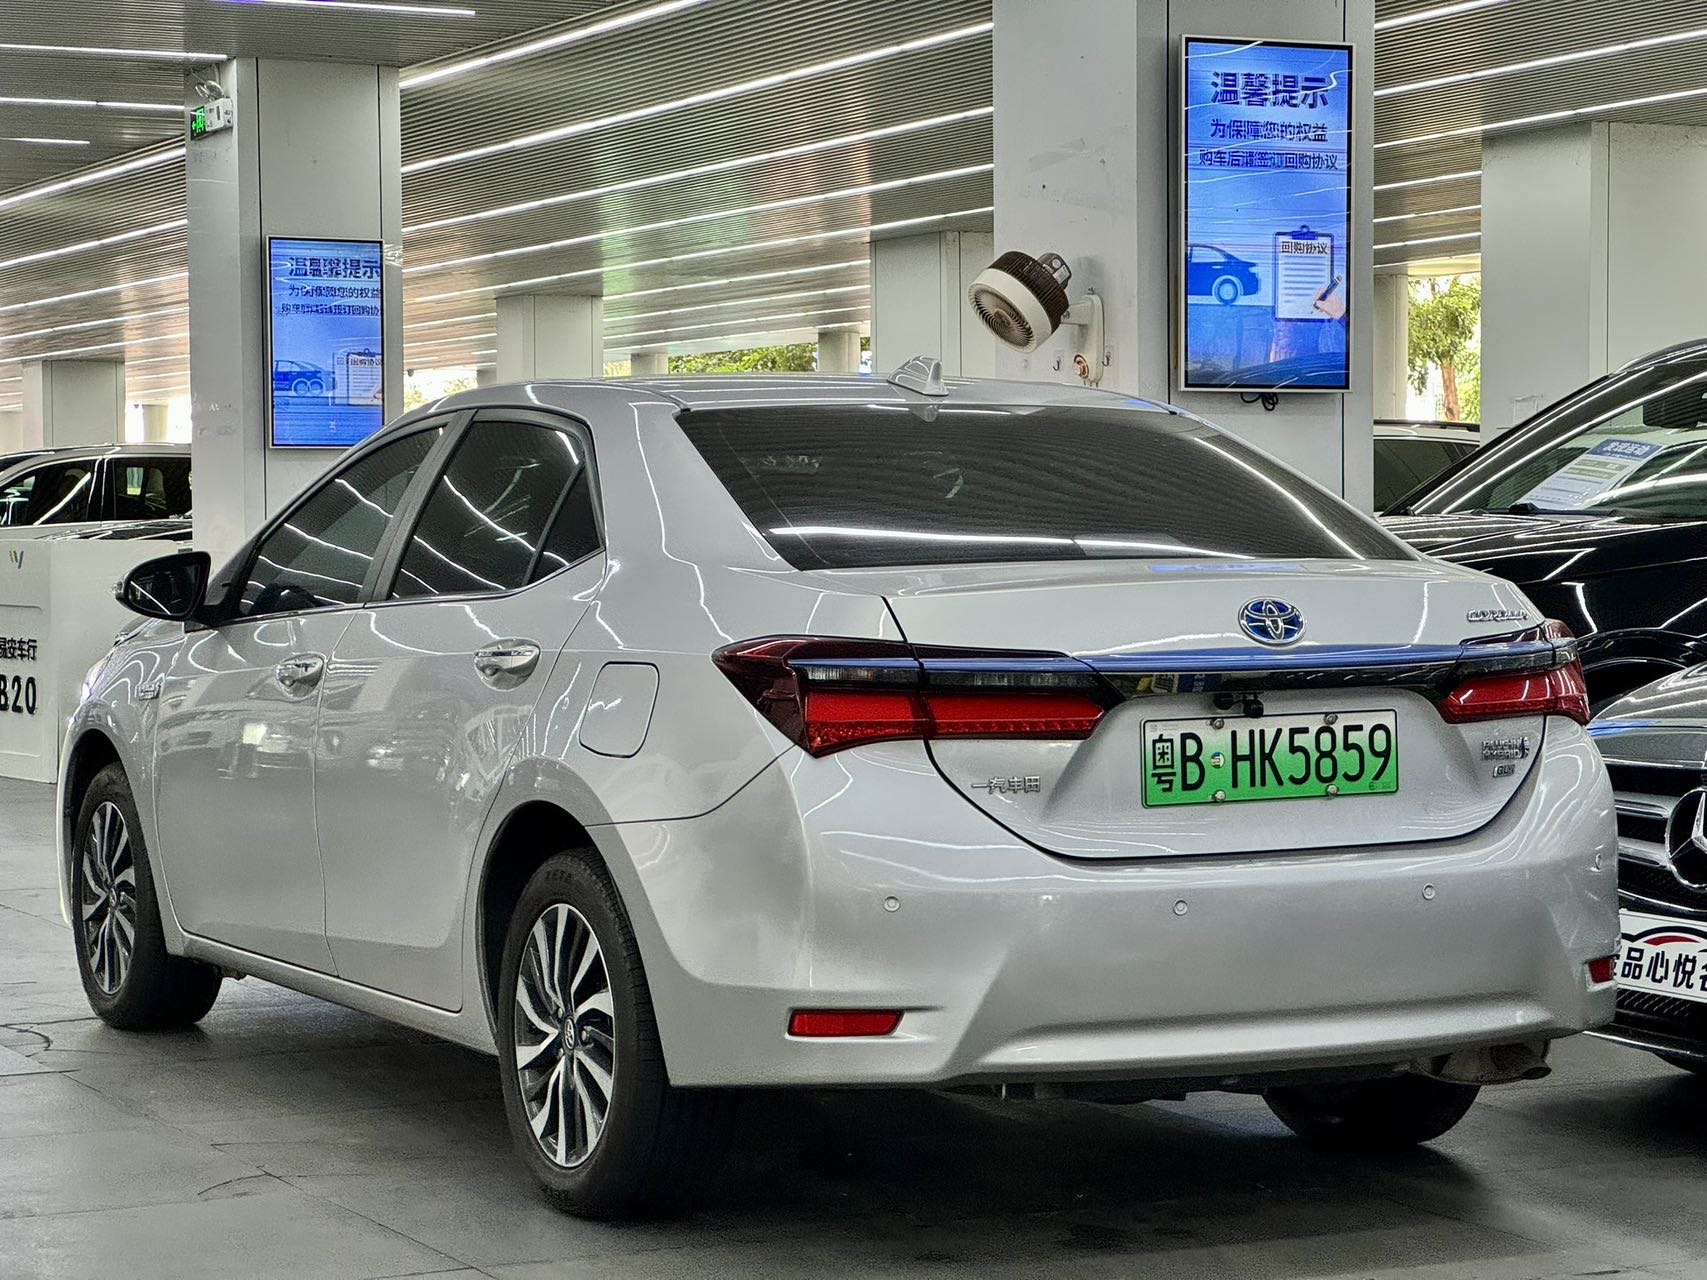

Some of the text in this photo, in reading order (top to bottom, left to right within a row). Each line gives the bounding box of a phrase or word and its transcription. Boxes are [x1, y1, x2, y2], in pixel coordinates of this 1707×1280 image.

[1210, 71, 1329, 109] 温馨提示
[1230, 723, 1392, 788] HK5859
[1614, 946, 1707, 992] 品心悦
